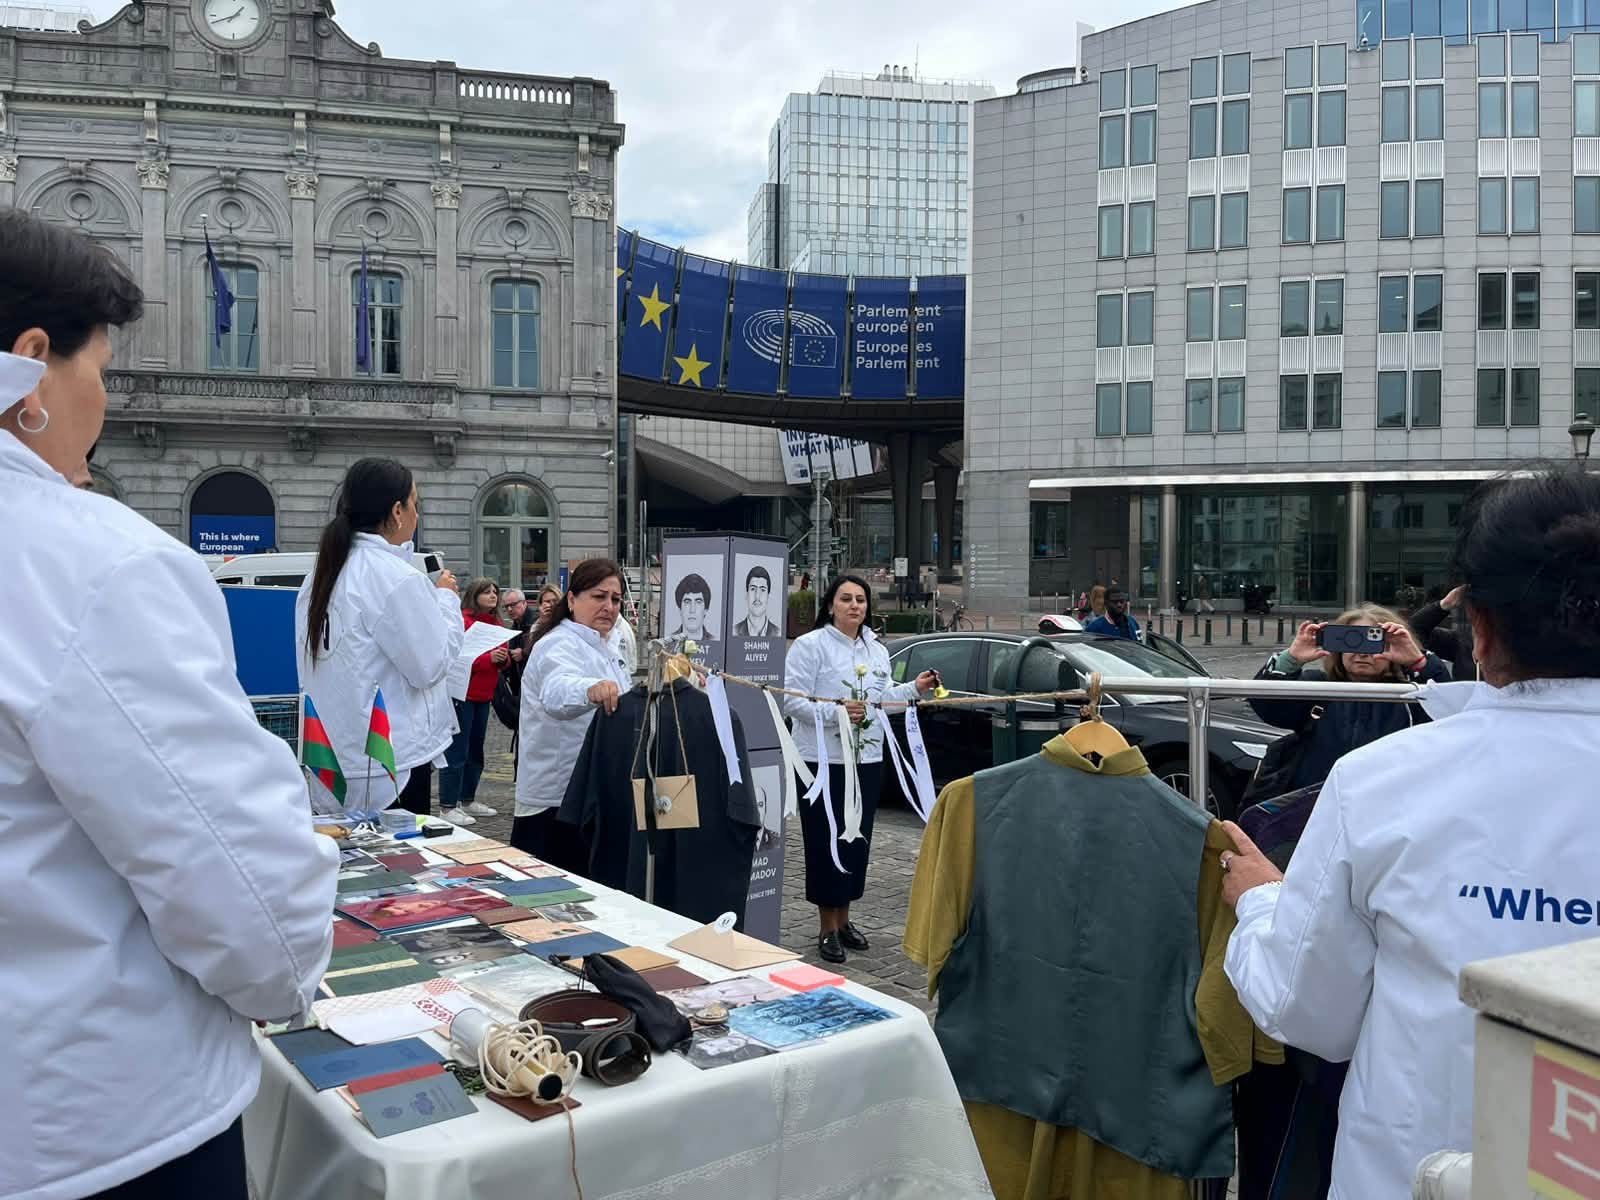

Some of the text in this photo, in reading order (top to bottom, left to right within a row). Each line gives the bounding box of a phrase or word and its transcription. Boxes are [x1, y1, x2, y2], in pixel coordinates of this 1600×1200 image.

[857, 304, 941, 317] Parlement
[857, 320, 934, 335] européen
[856, 340, 933, 355] Europees
[856, 357, 940, 369] Parlement
[788, 440, 823, 458] WHAT
[200, 532, 260, 541] This is where
[199, 543, 244, 552] European
[744, 641, 770, 651] SHAHIN
[744, 653, 768, 662] ALIYEV
